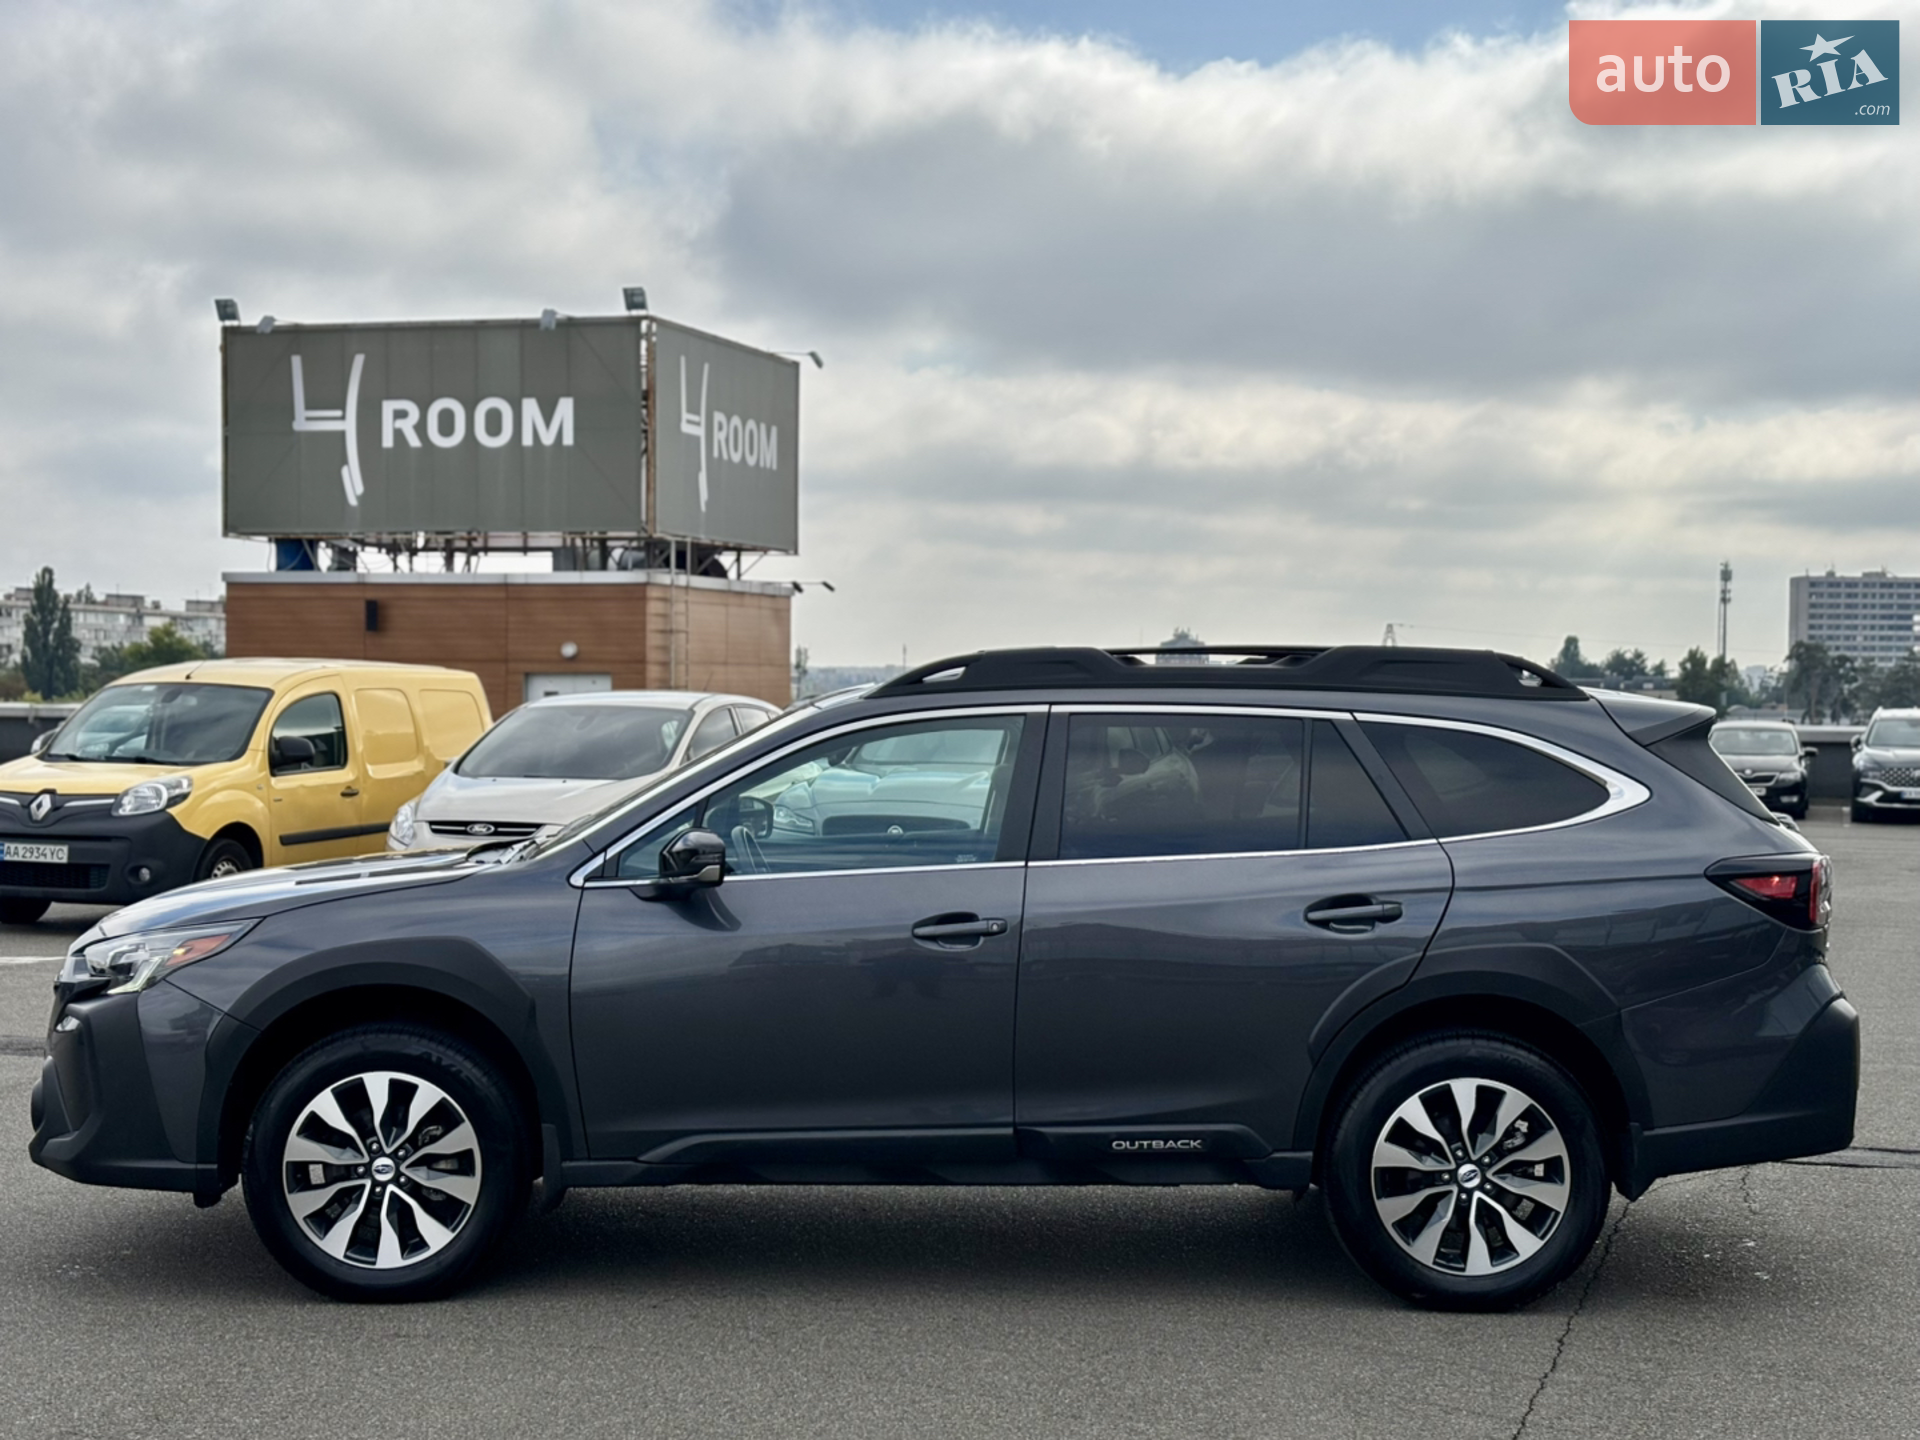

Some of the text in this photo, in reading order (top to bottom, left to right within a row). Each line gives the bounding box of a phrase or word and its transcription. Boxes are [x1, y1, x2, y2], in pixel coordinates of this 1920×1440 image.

[381, 397, 575, 449] ROOM
[713, 410, 778, 471] ROOM
[1111, 1139, 1203, 1150] OUTBACK
